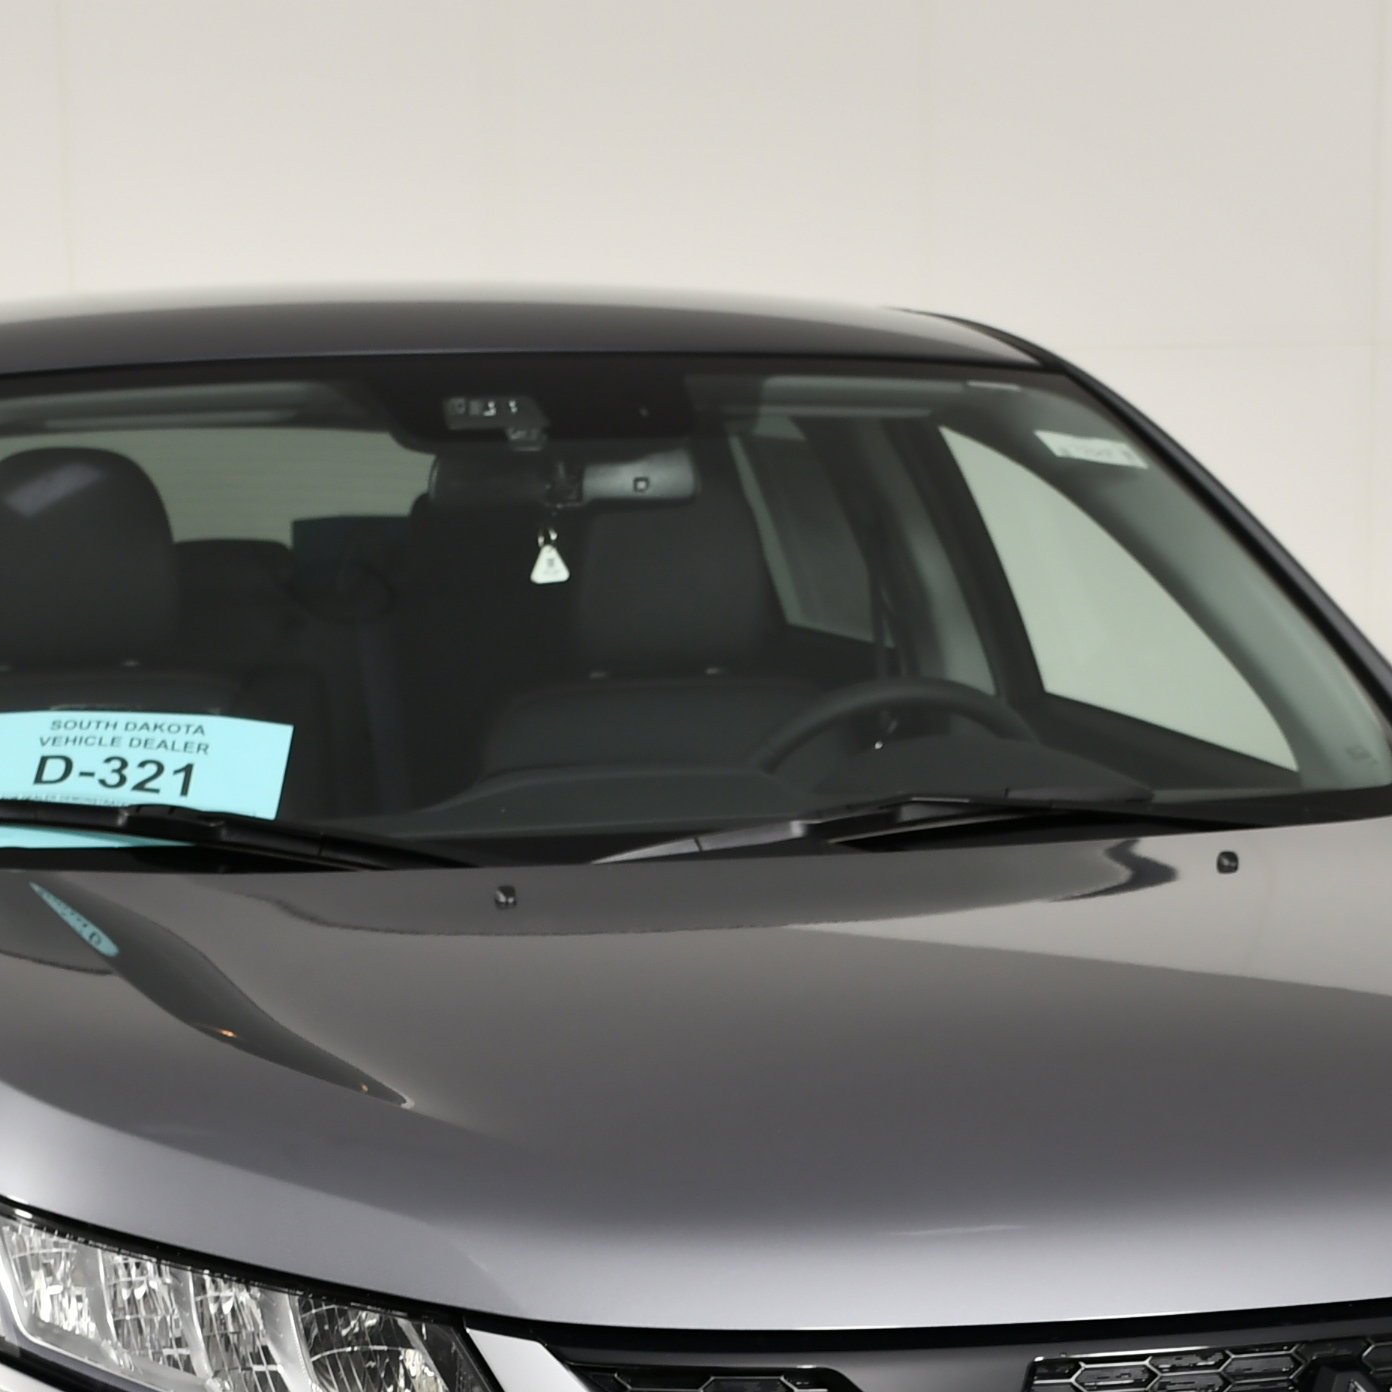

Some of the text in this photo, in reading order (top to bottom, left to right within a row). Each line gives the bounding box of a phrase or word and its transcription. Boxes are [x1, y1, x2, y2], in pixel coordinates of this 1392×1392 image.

[50, 719, 206, 736] SOUTH DAKOTA
[39, 735, 210, 756] VEHICLE DEALER
[32, 754, 195, 798] D-321
